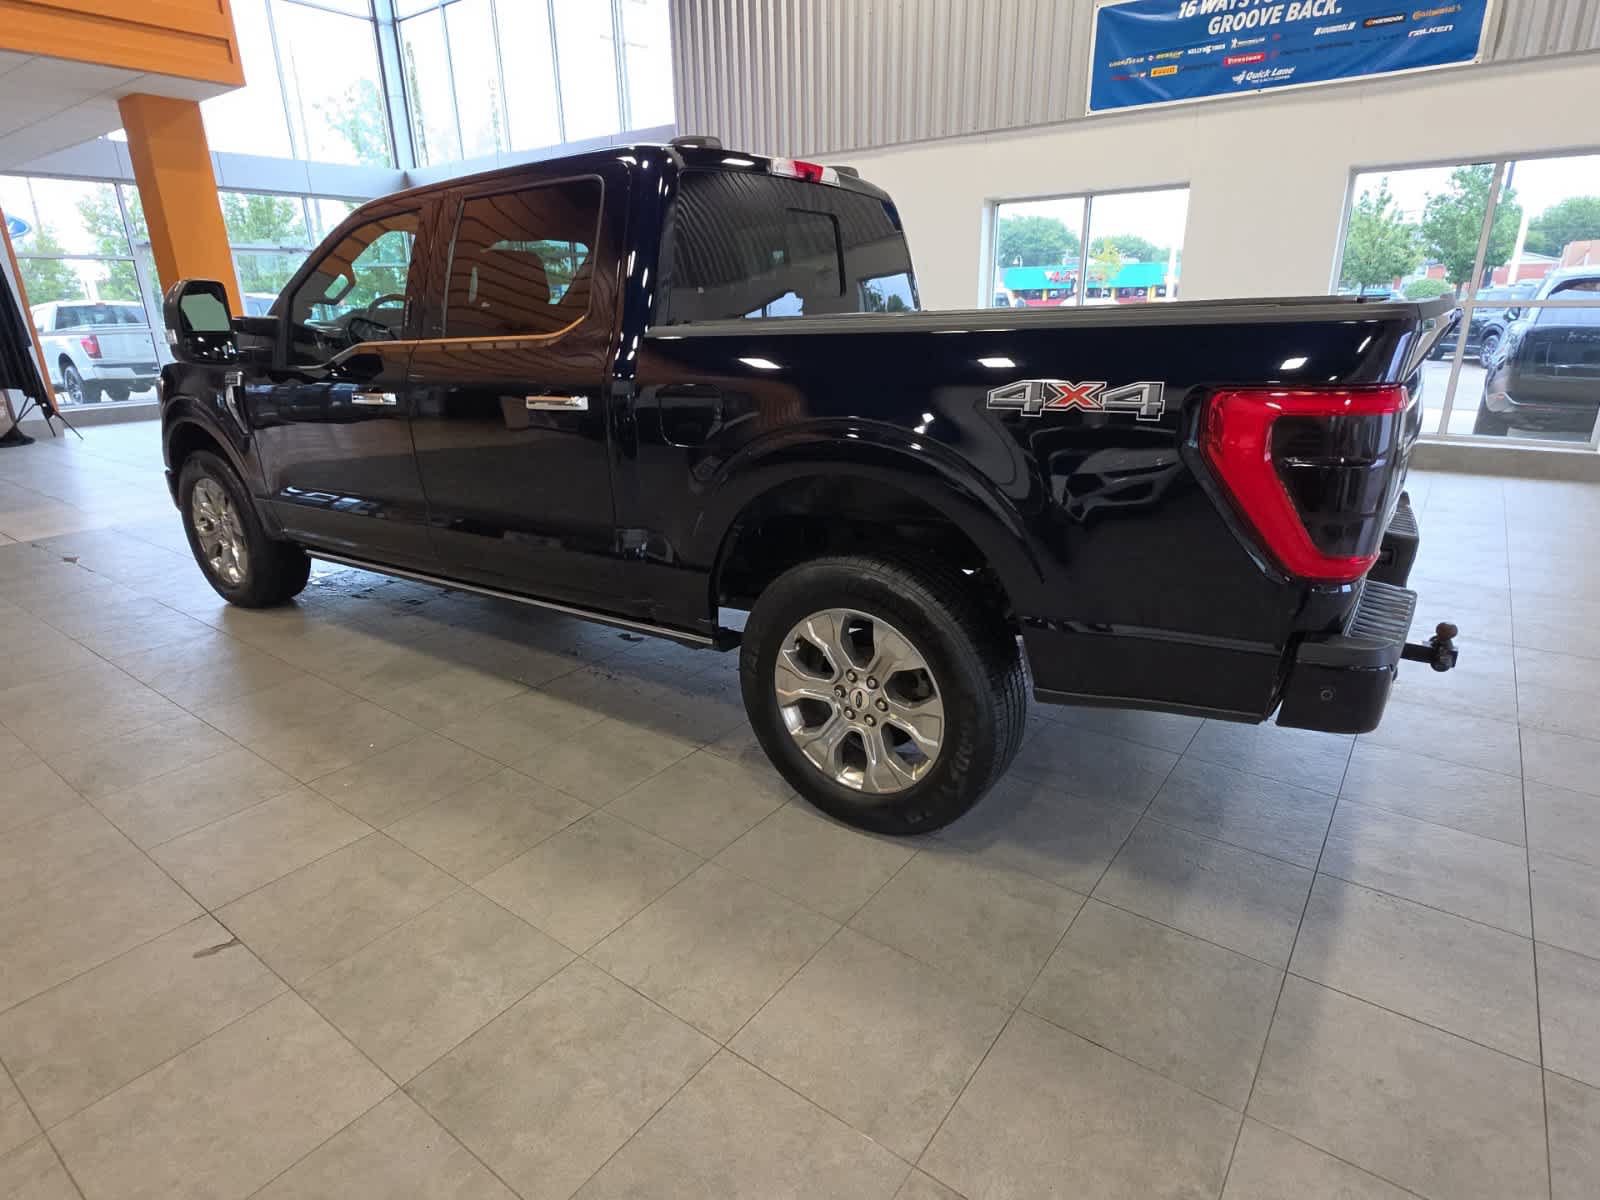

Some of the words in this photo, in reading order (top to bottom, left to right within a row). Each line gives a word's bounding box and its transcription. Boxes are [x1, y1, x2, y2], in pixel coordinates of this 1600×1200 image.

[1178, 1, 1198, 19] 16
[1208, 4, 1285, 35] GROOVE
[1285, 0, 1342, 22] BACK.
[1246, 69, 1271, 82] Quick
[1271, 66, 1296, 76] Lane
